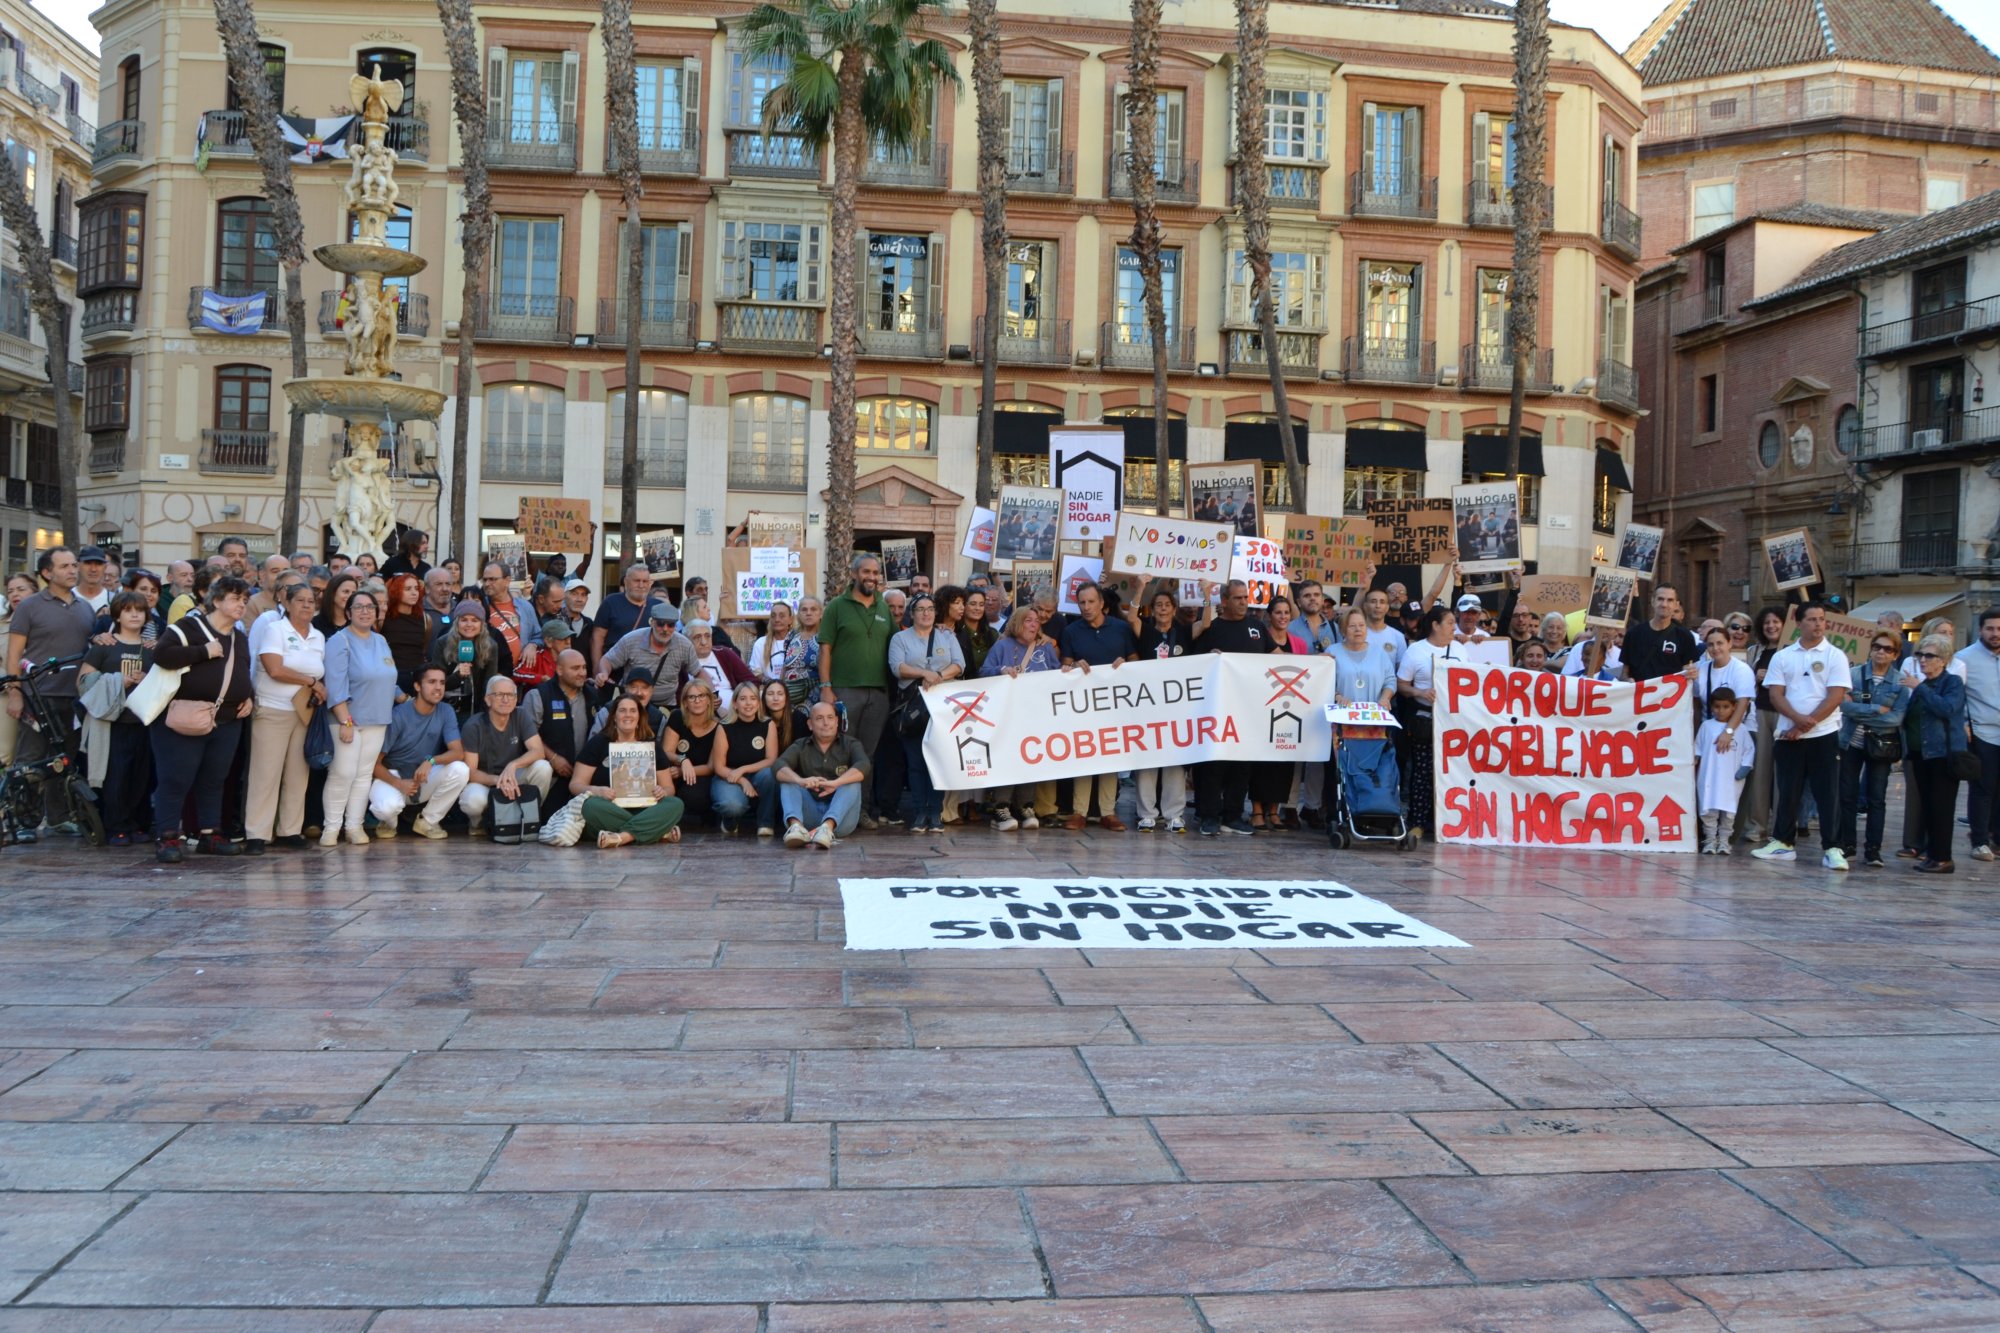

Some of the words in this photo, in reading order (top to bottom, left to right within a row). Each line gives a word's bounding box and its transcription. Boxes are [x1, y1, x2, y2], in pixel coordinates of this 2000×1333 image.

[1192, 479, 1208, 489] UN
[1212, 476, 1254, 488] HOGAR
[520, 497, 561, 508] QUIERO
[1068, 491, 1103, 501] NADIE
[1455, 497, 1471, 505] UN
[1475, 493, 1516, 504] HOGAR
[1003, 496, 1017, 505] UN
[1021, 498, 1060, 510] HOGAR
[1068, 502, 1088, 511] SIN
[1366, 500, 1396, 514] NOS
[1068, 513, 1111, 522] HOGAR
[544, 519, 582, 534] MIEDO
[751, 522, 764, 531] UN
[768, 522, 802, 531] HOGAR
[1320, 518, 1348, 532] HOY
[1129, 525, 1159, 543] NO
[1165, 531, 1216, 549] SOMOS
[1287, 529, 1314, 541] NOS
[500, 541, 525, 549] HOGAR
[1247, 541, 1278, 559] SOY
[1286, 543, 1317, 555] PARA
[1381, 552, 1430, 565] HOGAR
[742, 575, 767, 588] ¿QUÉ
[769, 576, 799, 588] PASA?
[1325, 569, 1367, 584] HOGAR
[1608, 575, 1634, 584] HOGAR
[752, 589, 772, 600] QUE
[1051, 682, 1156, 716] FUERA
[1163, 677, 1205, 704] DE
[1447, 667, 1613, 718] PORQUE
[1348, 711, 1393, 721] REAL
[1020, 715, 1240, 765] COBERTURA
[625, 750, 655, 758] HOGAR
[889, 884, 1022, 898] POR
[1124, 921, 1420, 941] HOGAR
